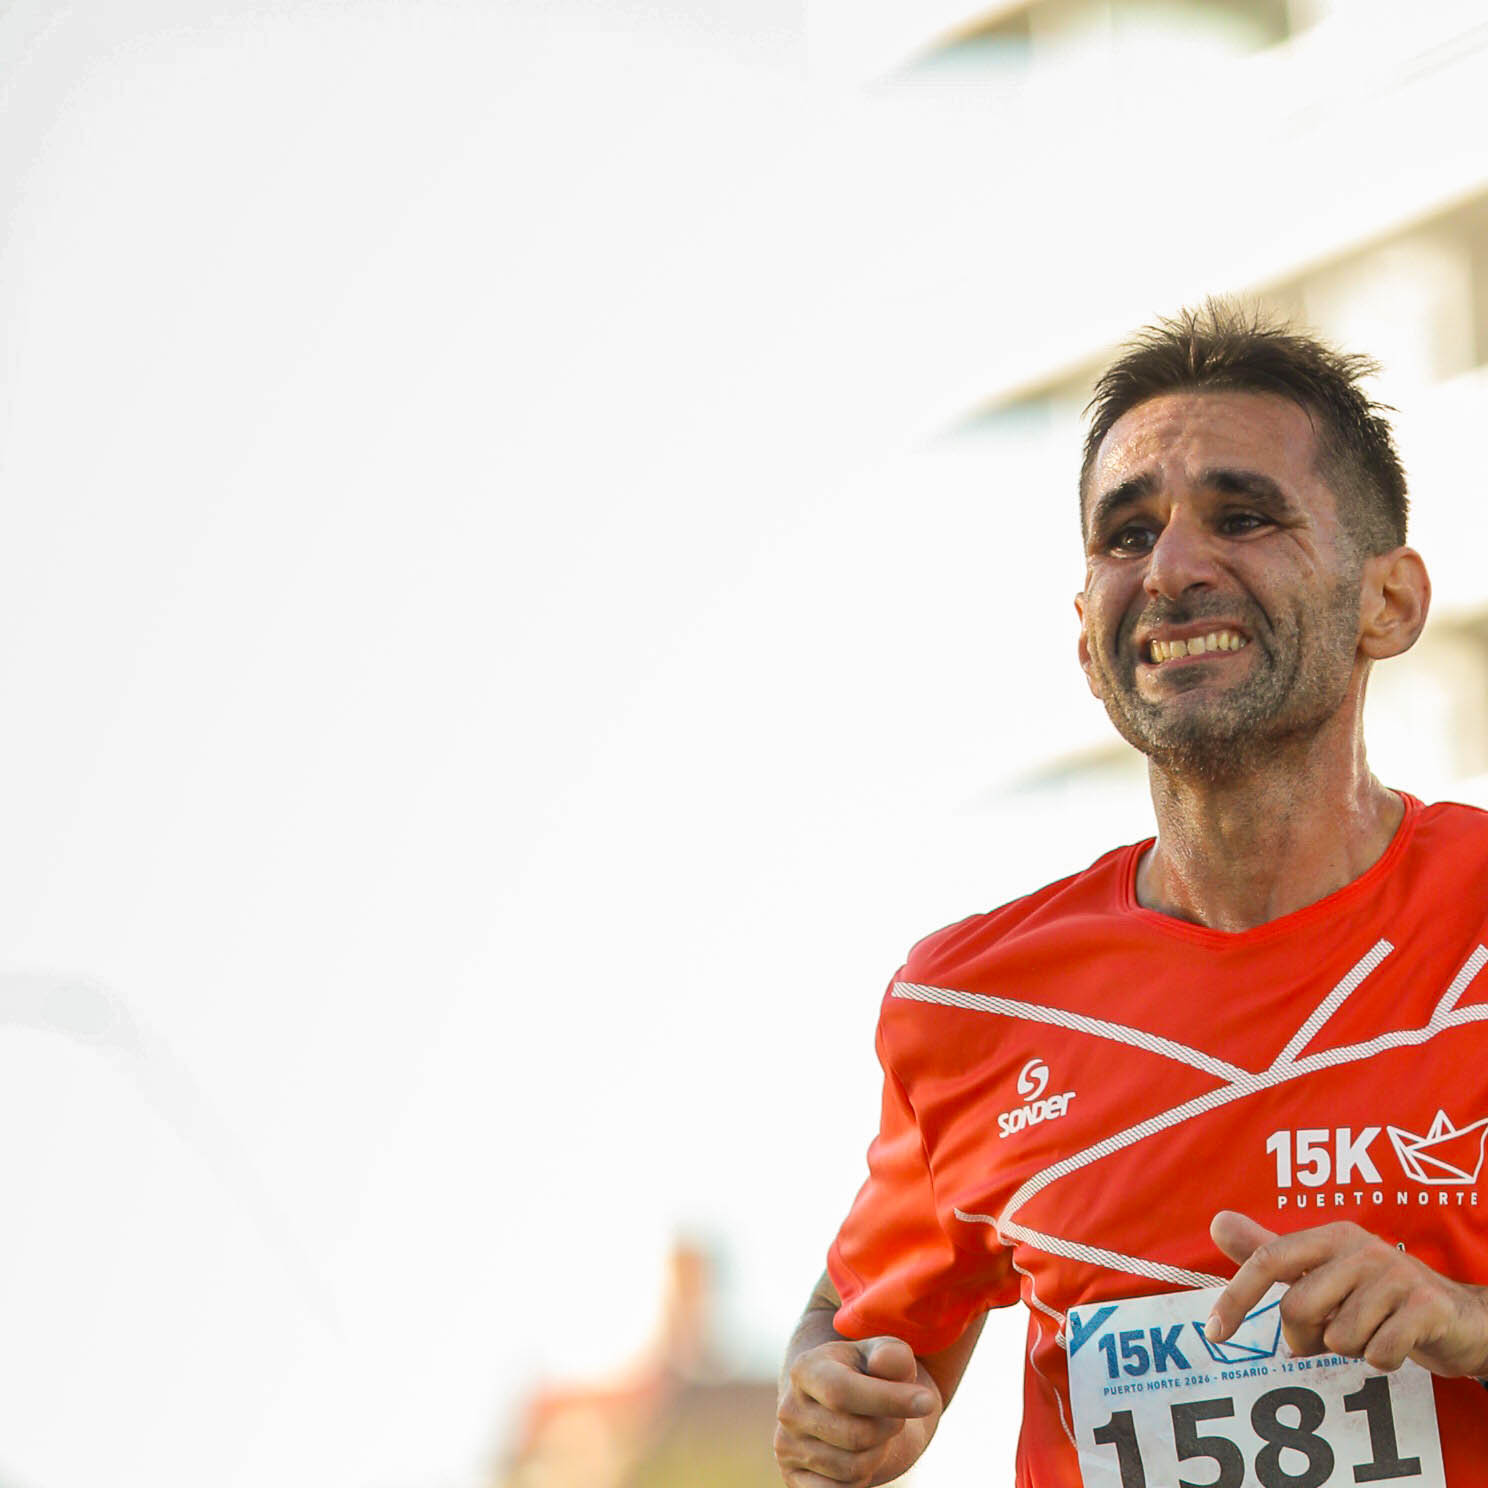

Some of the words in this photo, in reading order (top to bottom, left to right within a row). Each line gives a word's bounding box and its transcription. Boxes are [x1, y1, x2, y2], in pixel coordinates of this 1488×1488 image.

[1266, 1126, 1383, 1188] 15K
[1277, 1191, 1384, 1209] PUERTO
[1397, 1191, 1478, 1206] NORTE
[1098, 1323, 1192, 1379] 15K
[1103, 1383, 1144, 1396] PUERTO
[1147, 1378, 1181, 1391] NORTE
[1221, 1366, 1268, 1381] ROSARIO
[1281, 1363, 1294, 1373] 12
[1297, 1360, 1312, 1370] DE
[1316, 1355, 1349, 1368] ABRIL
